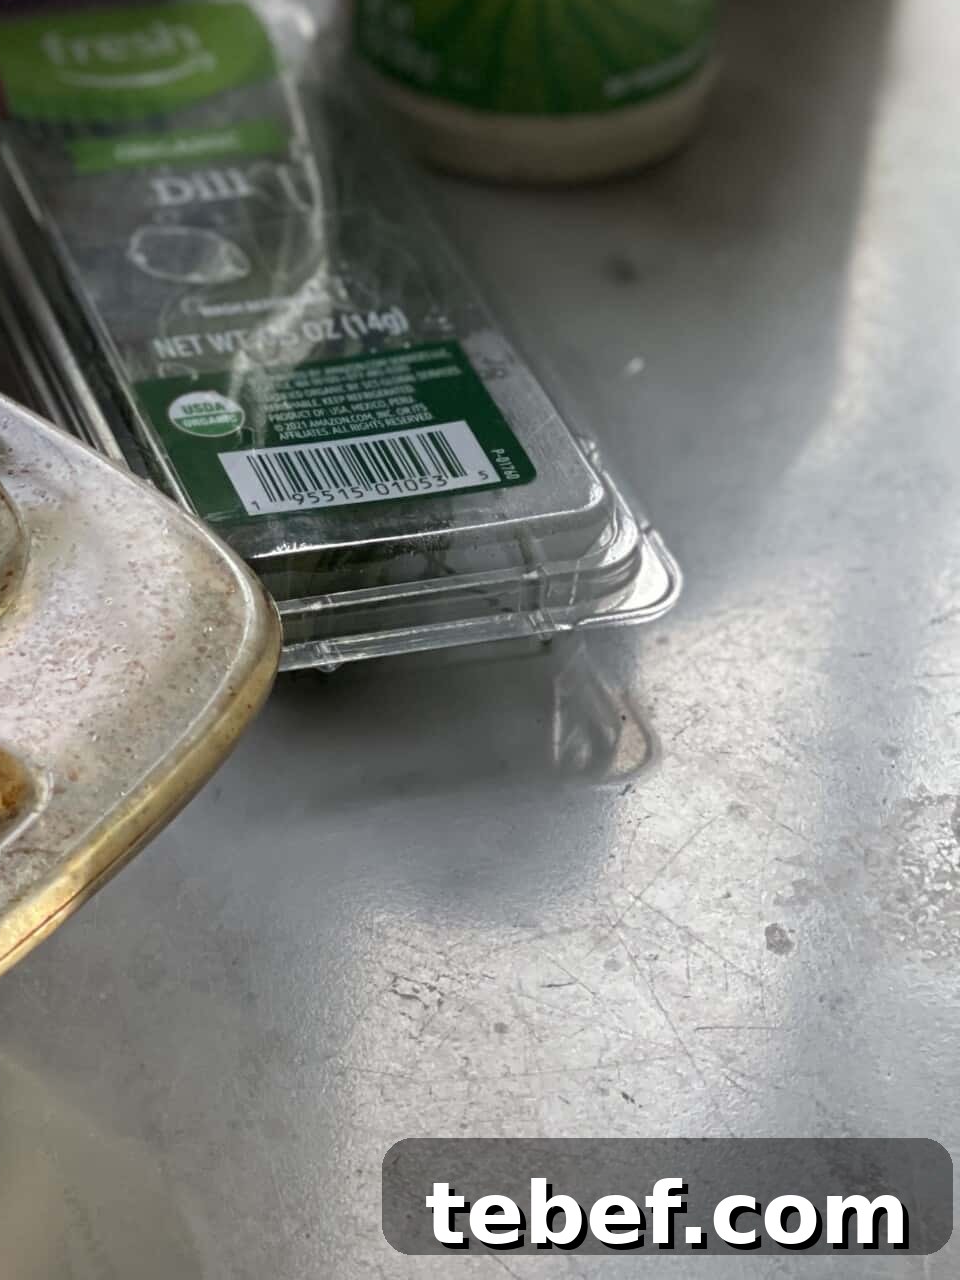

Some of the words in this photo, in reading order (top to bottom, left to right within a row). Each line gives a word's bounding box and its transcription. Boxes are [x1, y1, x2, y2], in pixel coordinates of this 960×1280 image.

[150, 168, 252, 205] Dill
[153, 334, 204, 359] NET
[302, 318, 342, 342] OZ
[342, 306, 409, 336] (14g)
[180, 401, 226, 416] USDA
[268, 409, 311, 423] PRODUCT
[313, 407, 327, 417] OF
[285, 419, 308, 432] 2021
[395, 406, 410, 417] OR
[332, 424, 350, 436] ALL
[350, 420, 385, 433] RIGHTS
[251, 501, 262, 511] 1
[292, 487, 365, 506] 95515
[375, 475, 449, 496] 01053
[478, 470, 490, 481] 5
